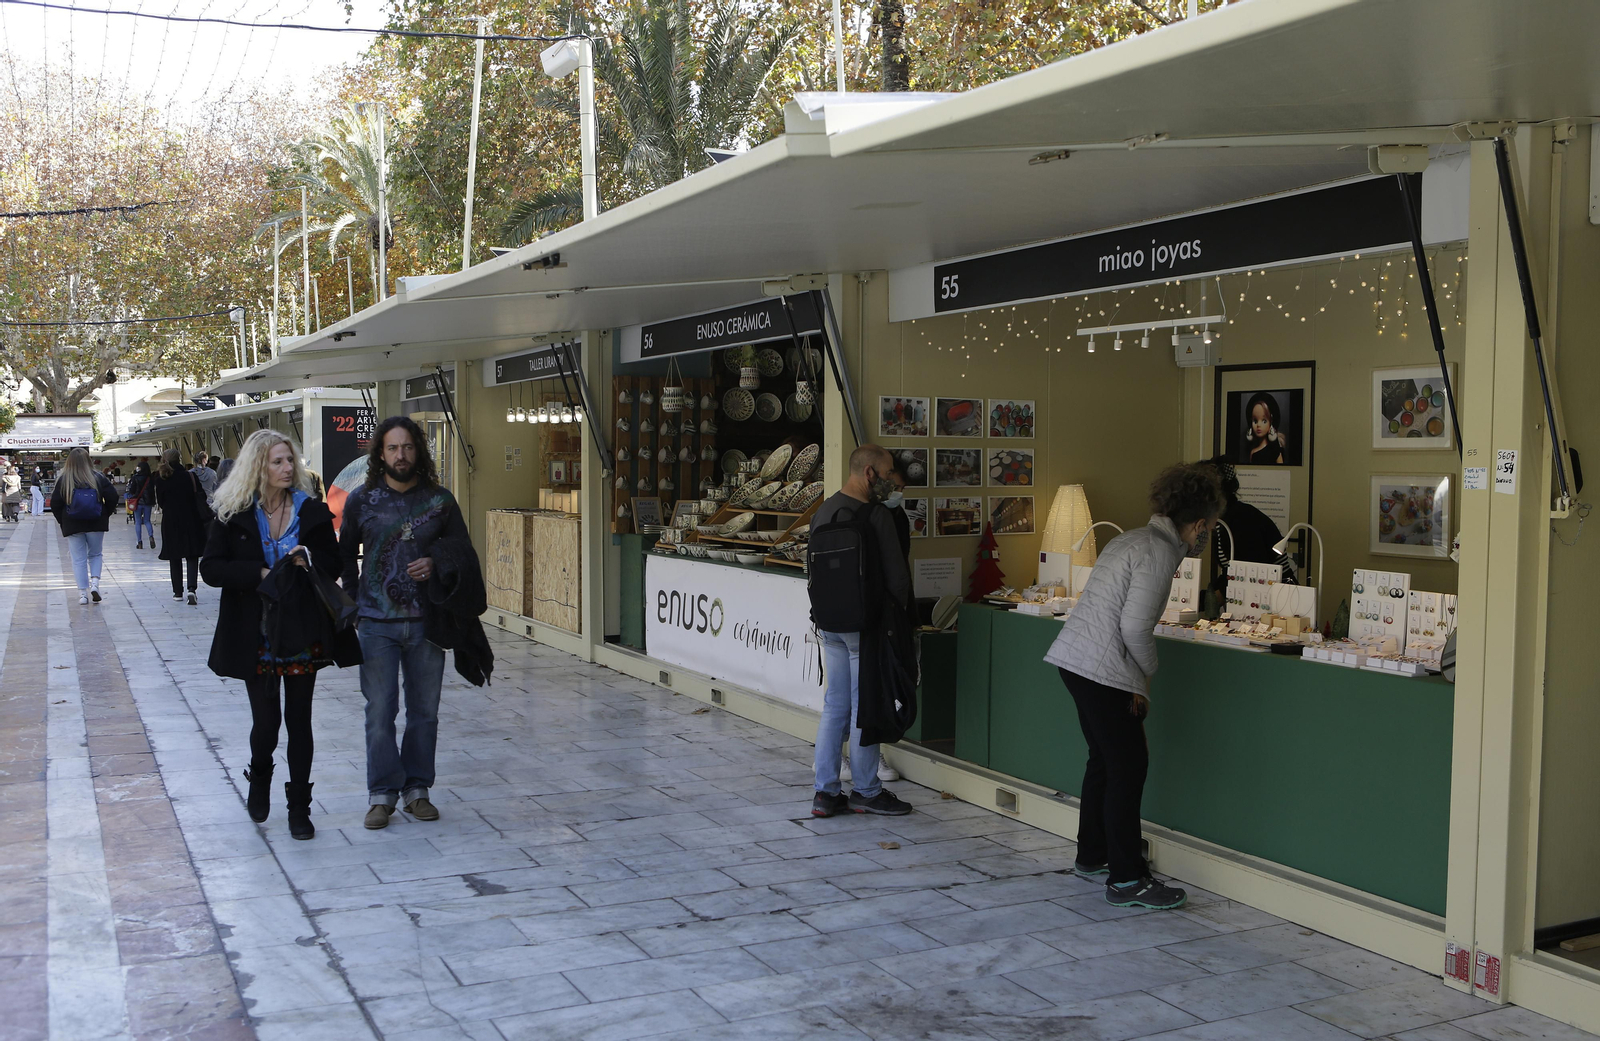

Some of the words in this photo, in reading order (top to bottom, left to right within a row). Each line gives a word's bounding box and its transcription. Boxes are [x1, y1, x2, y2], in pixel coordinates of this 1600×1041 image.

[1098, 245, 1145, 273] miao
[1150, 239, 1202, 271] joyas
[940, 274, 960, 300] 55
[696, 319, 725, 341] ENUSO
[726, 311, 771, 335] CERÁMICA
[643, 333, 654, 350] 56
[528, 357, 544, 371] TALLER
[356, 424, 375, 432] CRE
[657, 589, 724, 638] enuso
[733, 619, 793, 659] cerámica
